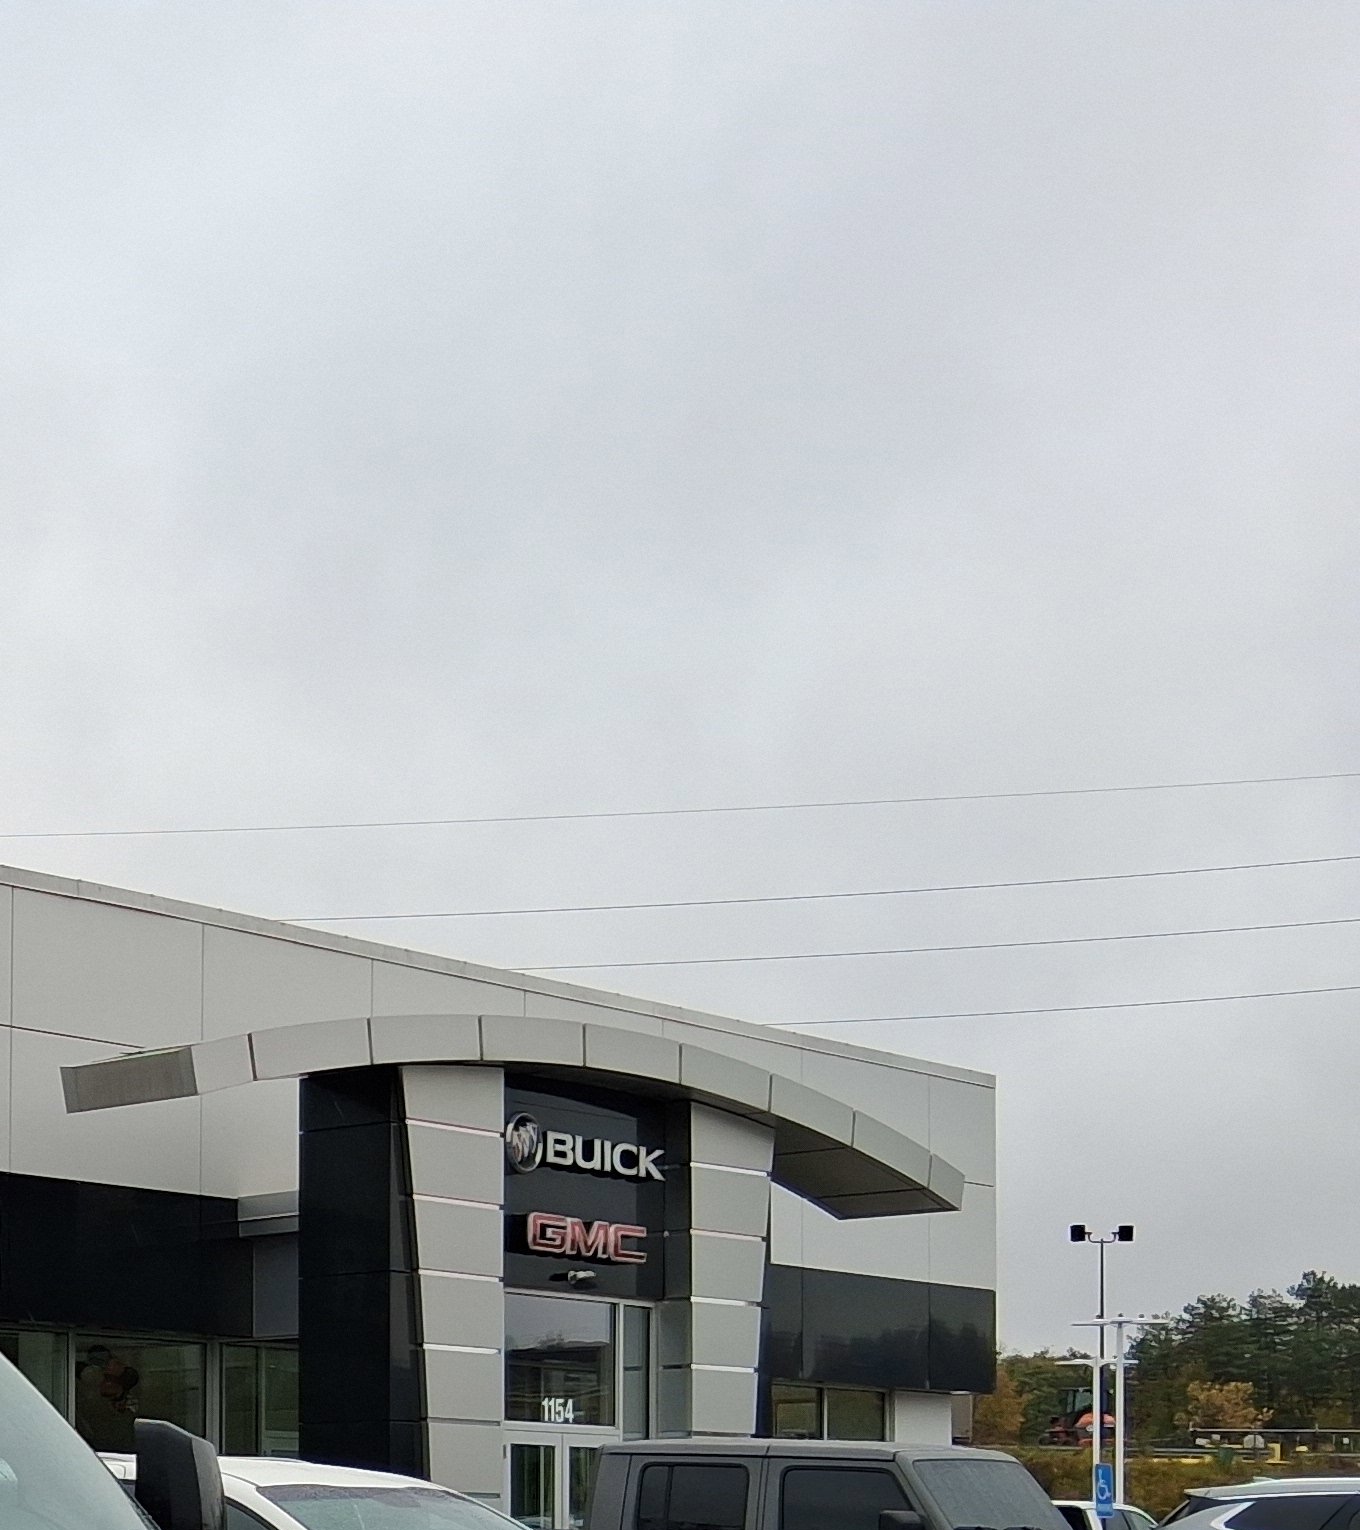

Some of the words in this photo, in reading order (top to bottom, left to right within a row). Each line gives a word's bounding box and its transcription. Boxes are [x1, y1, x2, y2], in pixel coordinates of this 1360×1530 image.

[546, 1130, 666, 1181] BUICK
[527, 1211, 647, 1264] GMC
[541, 1397, 574, 1423] 1154
